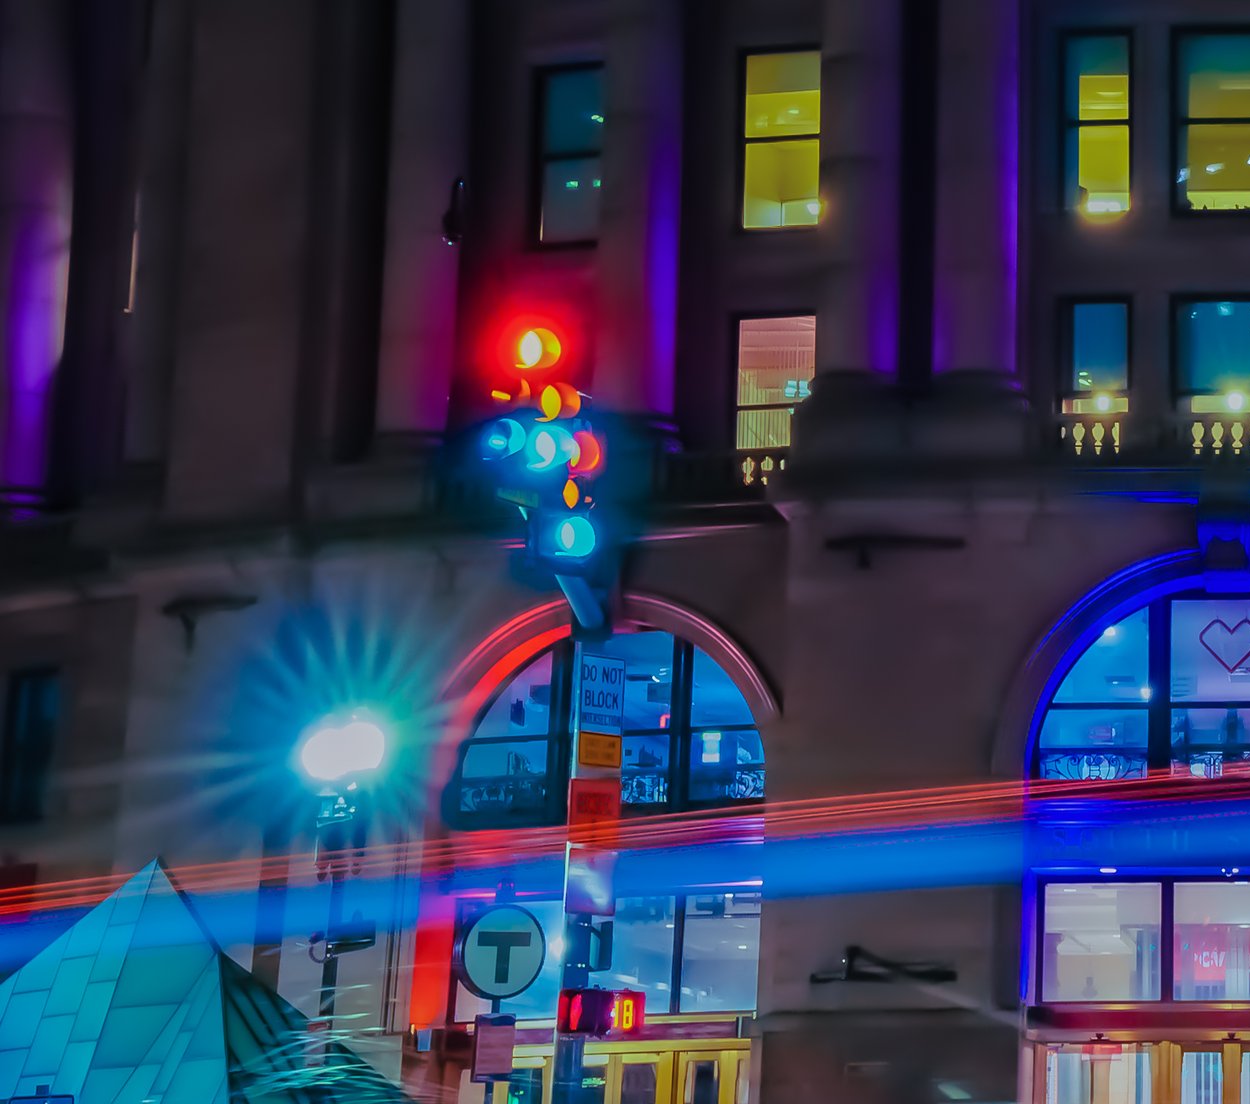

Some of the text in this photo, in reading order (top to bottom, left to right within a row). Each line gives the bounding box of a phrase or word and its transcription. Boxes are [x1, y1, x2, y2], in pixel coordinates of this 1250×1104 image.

[583, 664, 624, 686] DO NOT
[584, 690, 620, 710] BLOCK
[477, 931, 532, 985] T
